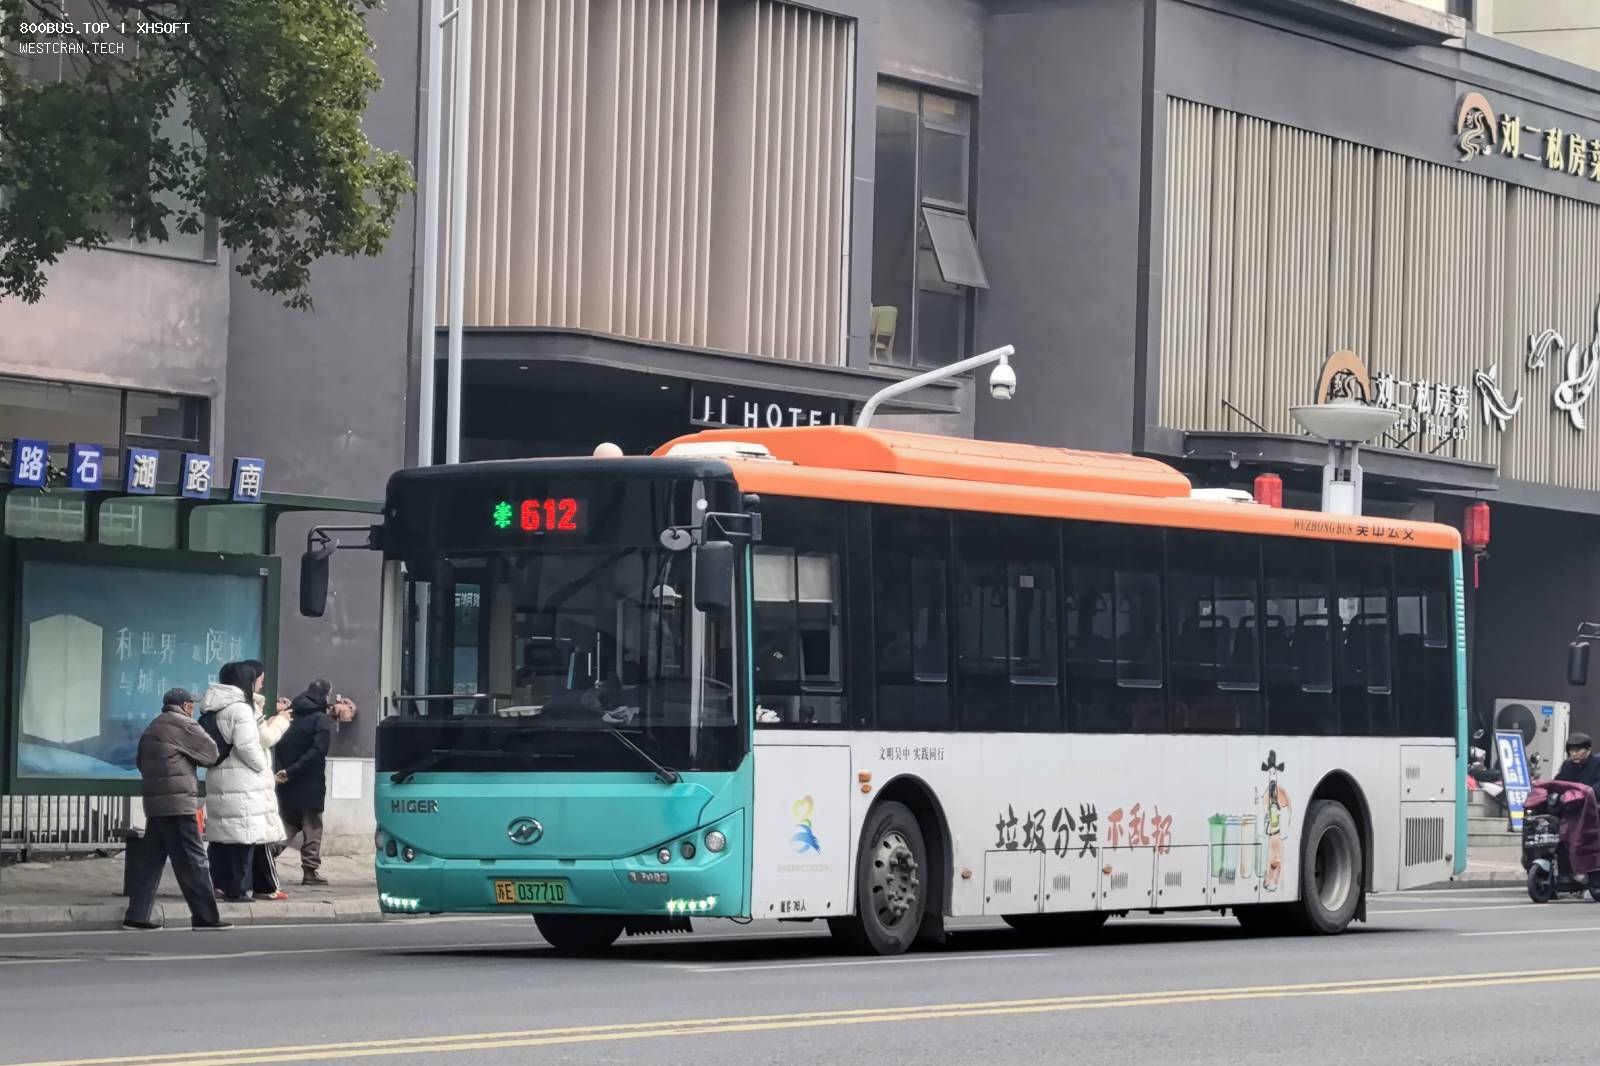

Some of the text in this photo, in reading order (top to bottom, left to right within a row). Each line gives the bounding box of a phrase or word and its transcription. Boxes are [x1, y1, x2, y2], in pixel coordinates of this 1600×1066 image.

[703, 395, 727, 425] JI
[1376, 372, 1469, 420] 刘二私房菜
[521, 498, 577, 530] 612
[391, 800, 438, 813] HIGER
